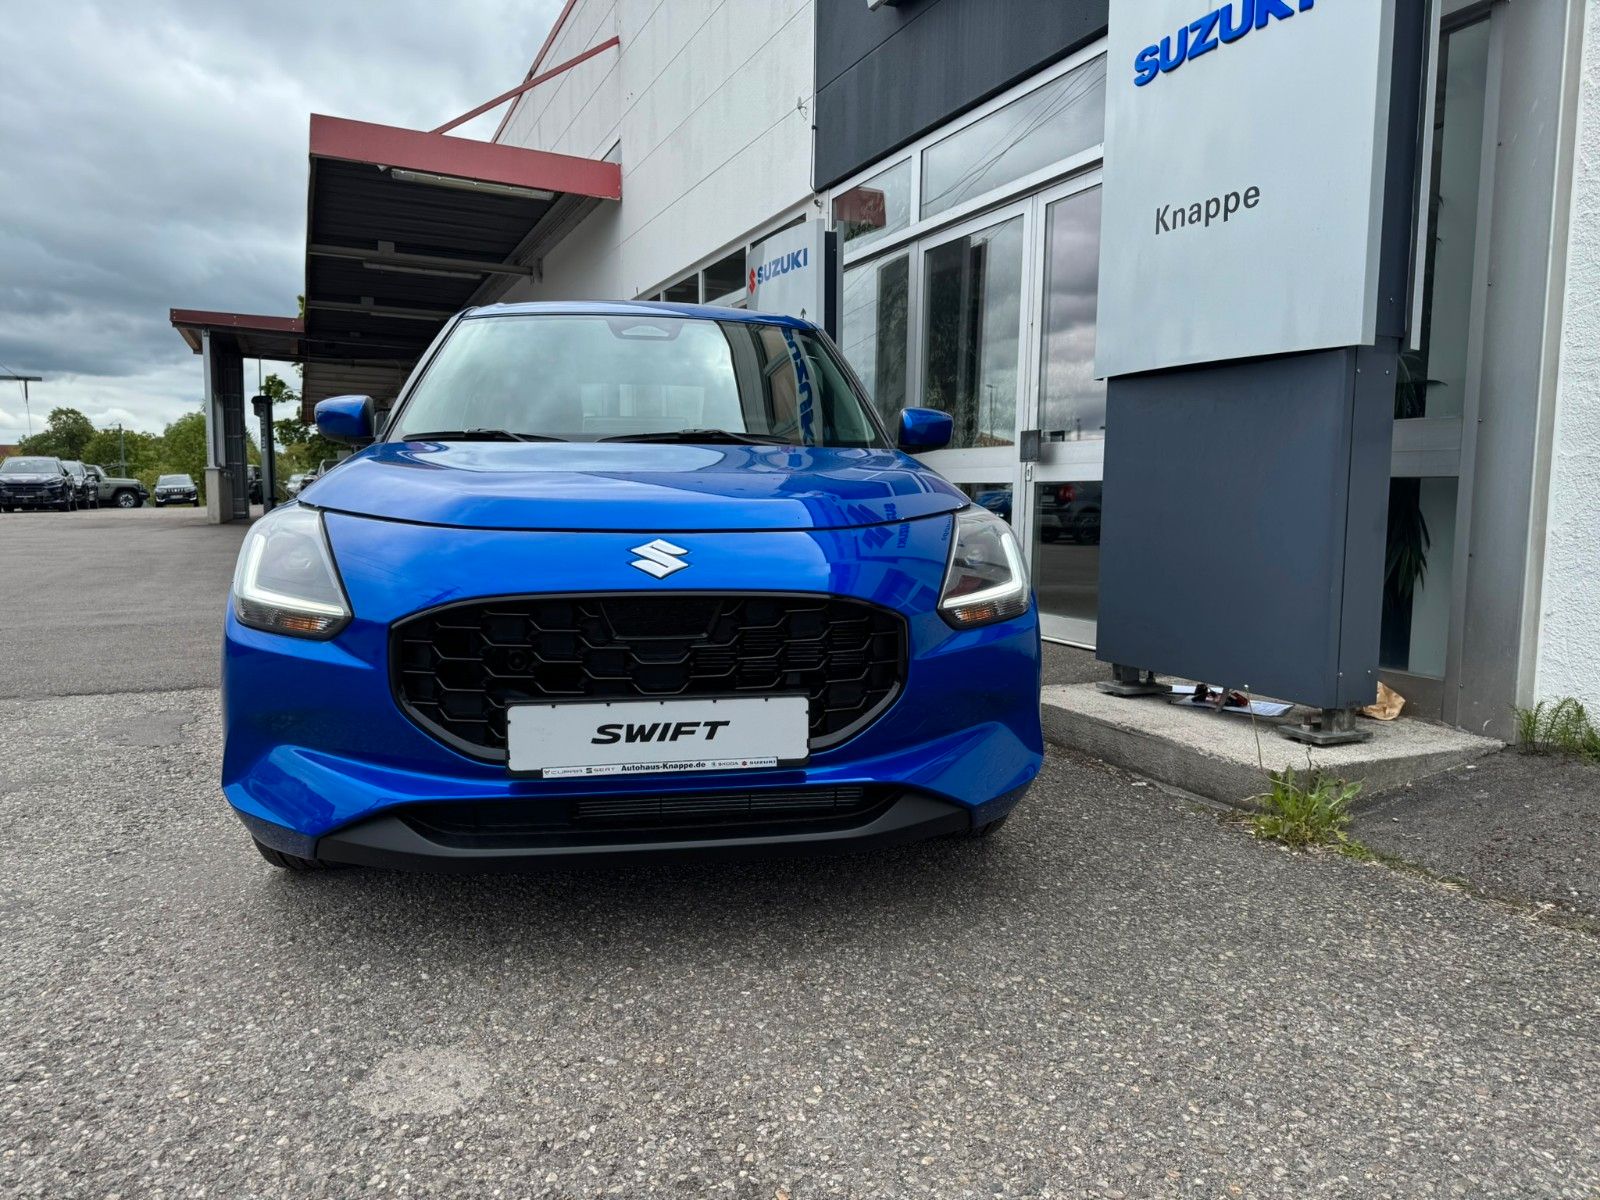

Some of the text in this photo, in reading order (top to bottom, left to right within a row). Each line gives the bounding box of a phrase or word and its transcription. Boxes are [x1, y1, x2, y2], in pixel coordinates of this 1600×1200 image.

[1134, 0, 1314, 87] SUZUK
[1155, 185, 1260, 235] Knappe
[757, 247, 808, 285] SUZUKI
[591, 720, 731, 744] SWIFT
[621, 761, 706, 772] Autohaus-Knappe.de
